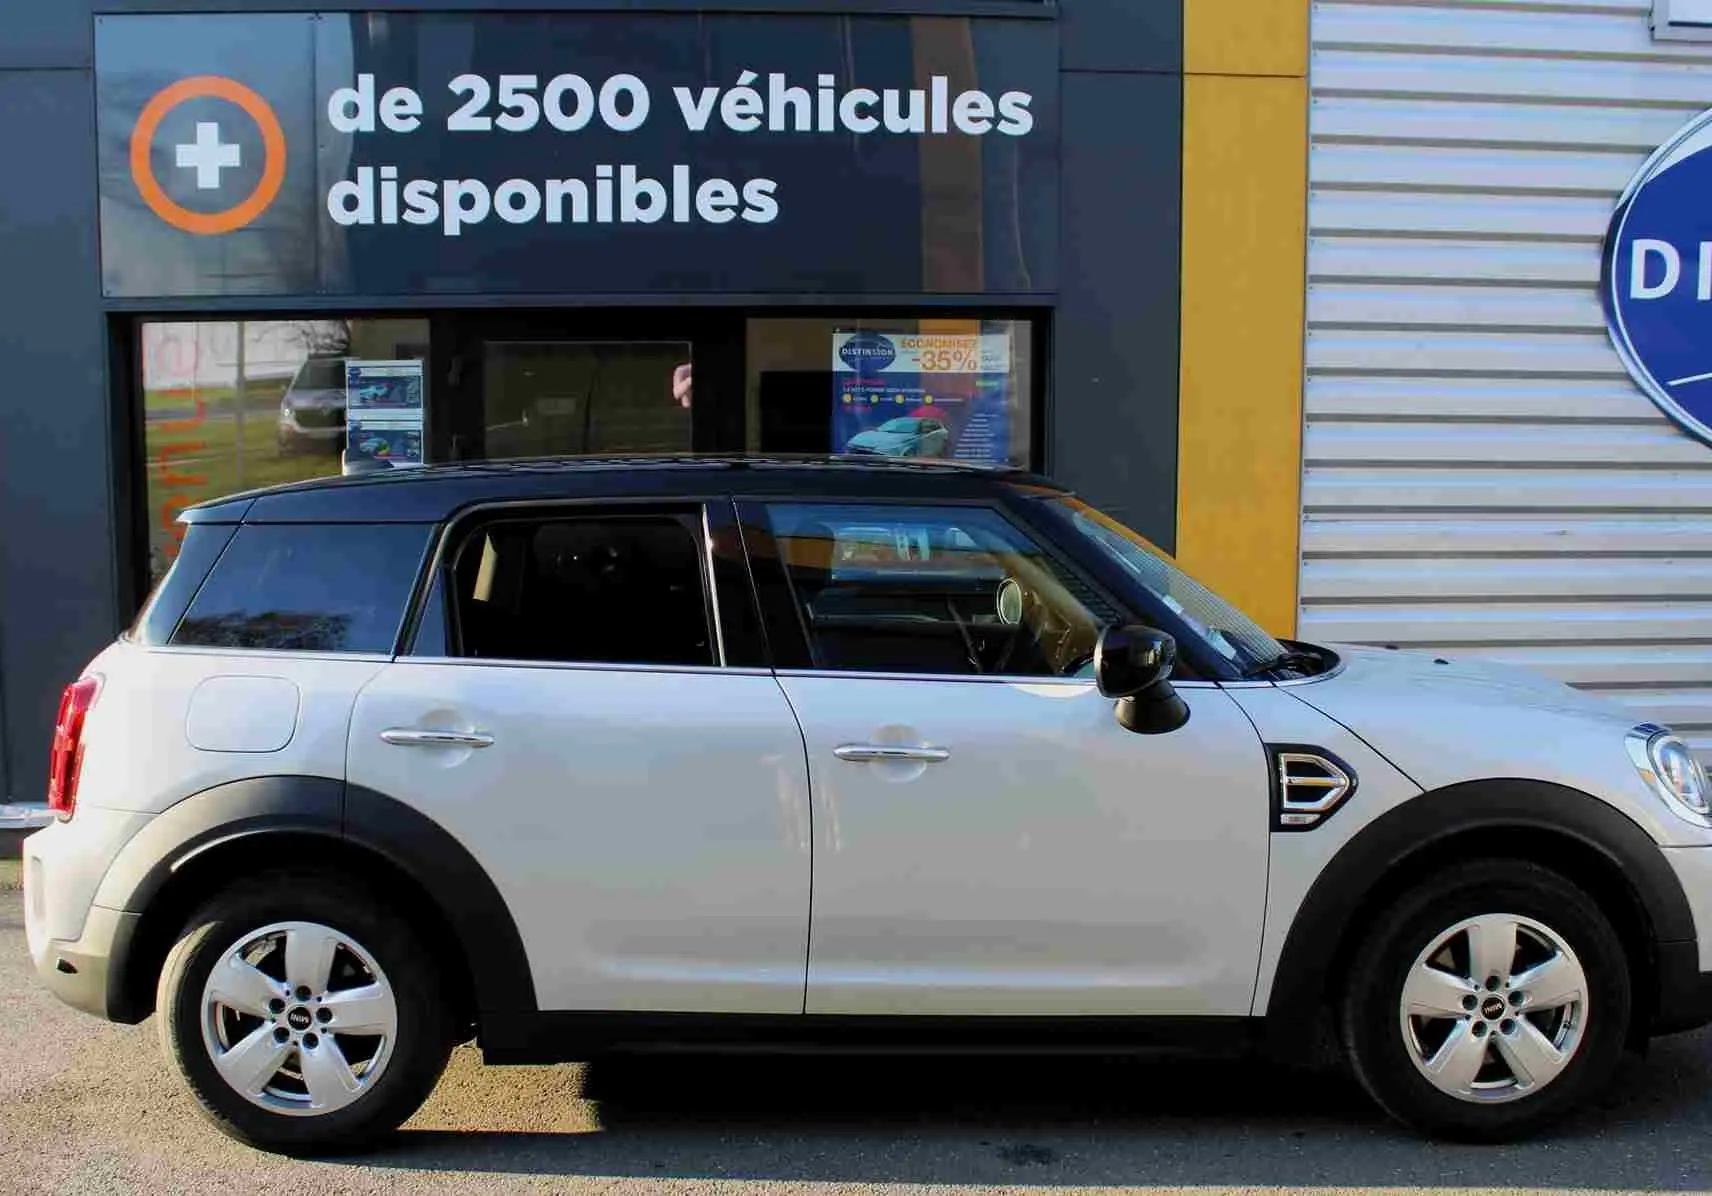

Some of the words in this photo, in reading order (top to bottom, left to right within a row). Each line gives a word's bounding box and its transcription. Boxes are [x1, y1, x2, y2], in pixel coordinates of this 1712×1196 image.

[327, 73, 423, 133] de
[447, 73, 651, 132] 2500
[672, 69, 1034, 136] véhicules
[327, 164, 779, 236] disponibles
[911, 350, 978, 371] -35%
